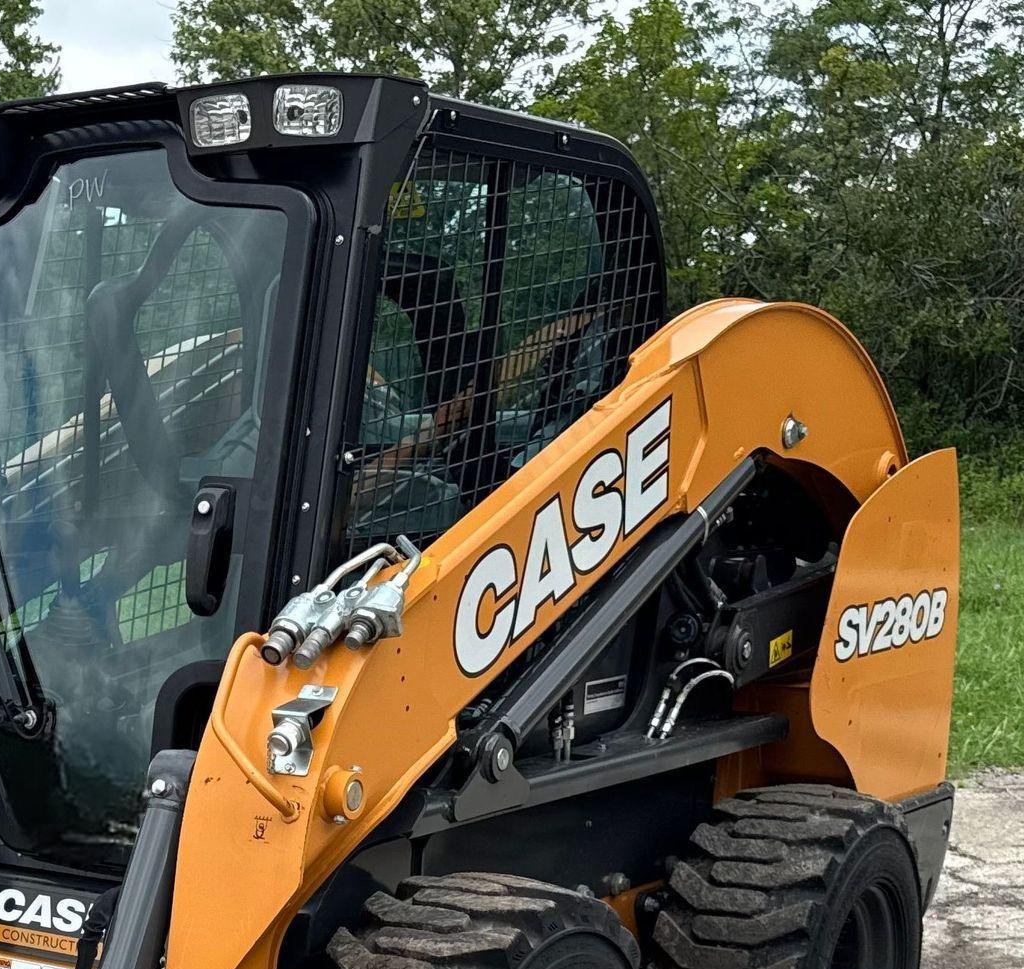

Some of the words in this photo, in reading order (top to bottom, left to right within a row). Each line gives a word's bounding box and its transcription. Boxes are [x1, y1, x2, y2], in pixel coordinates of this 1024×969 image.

[453, 393, 673, 679] CASE
[834, 587, 948, 663] SV280B
[2, 928, 77, 952] CONSTRUCT
